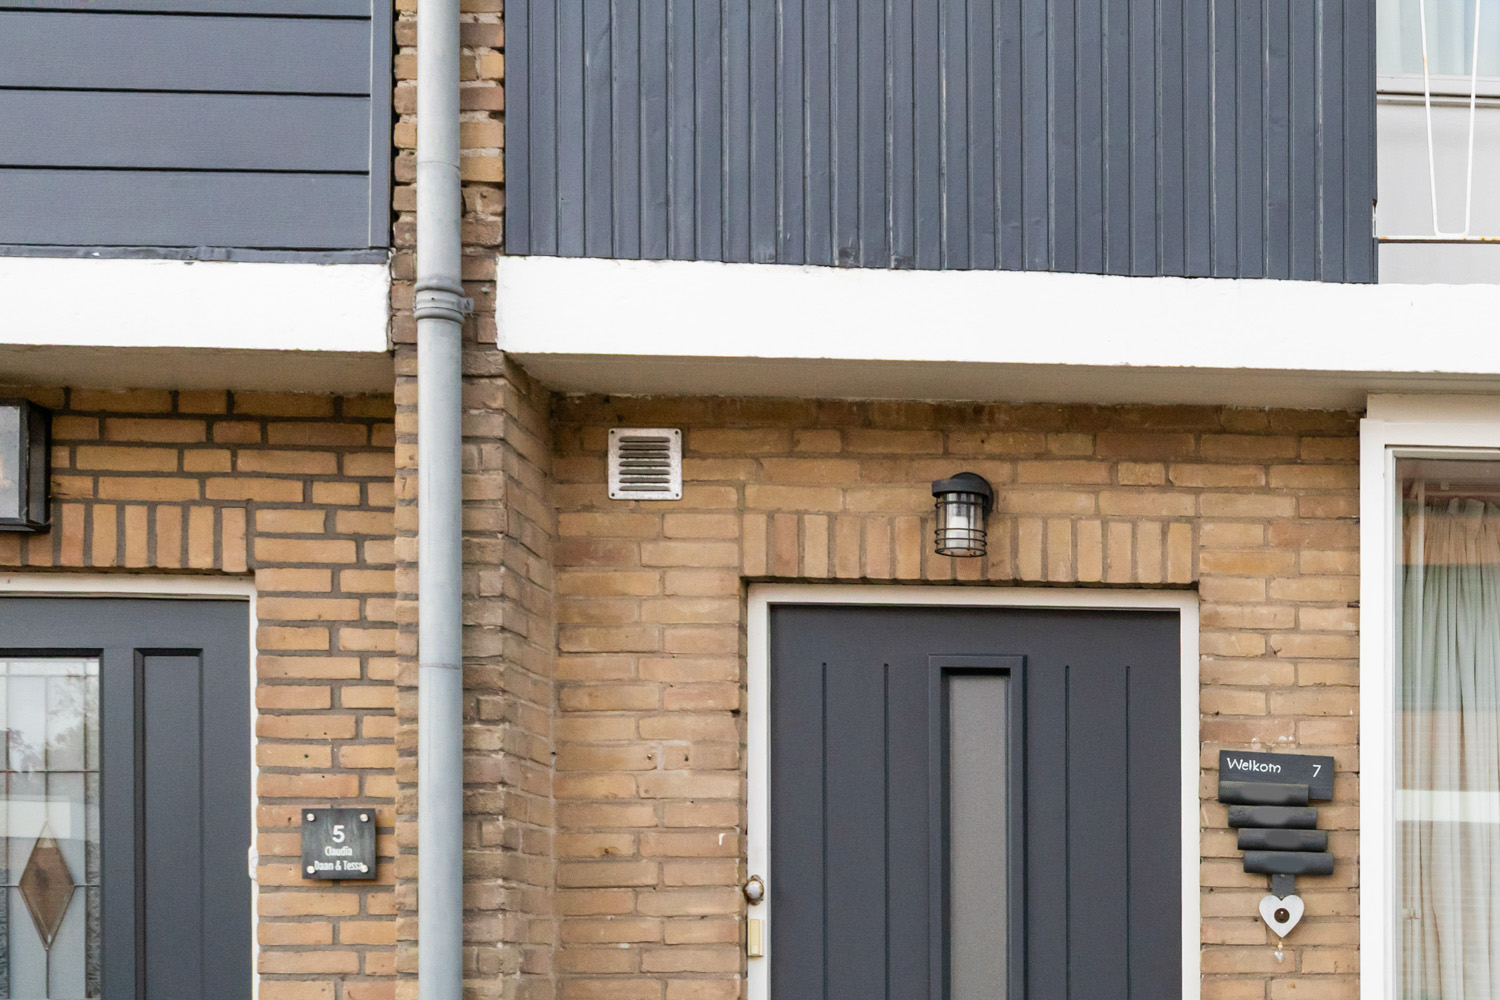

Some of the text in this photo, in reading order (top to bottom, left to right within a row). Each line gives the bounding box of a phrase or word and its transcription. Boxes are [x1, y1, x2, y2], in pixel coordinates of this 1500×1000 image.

[1226, 757, 1322, 778] Welkom 7
[332, 824, 346, 843] 5
[324, 845, 353, 857] Claudia
[313, 860, 334, 871] Daan
[334, 859, 342, 871] &
